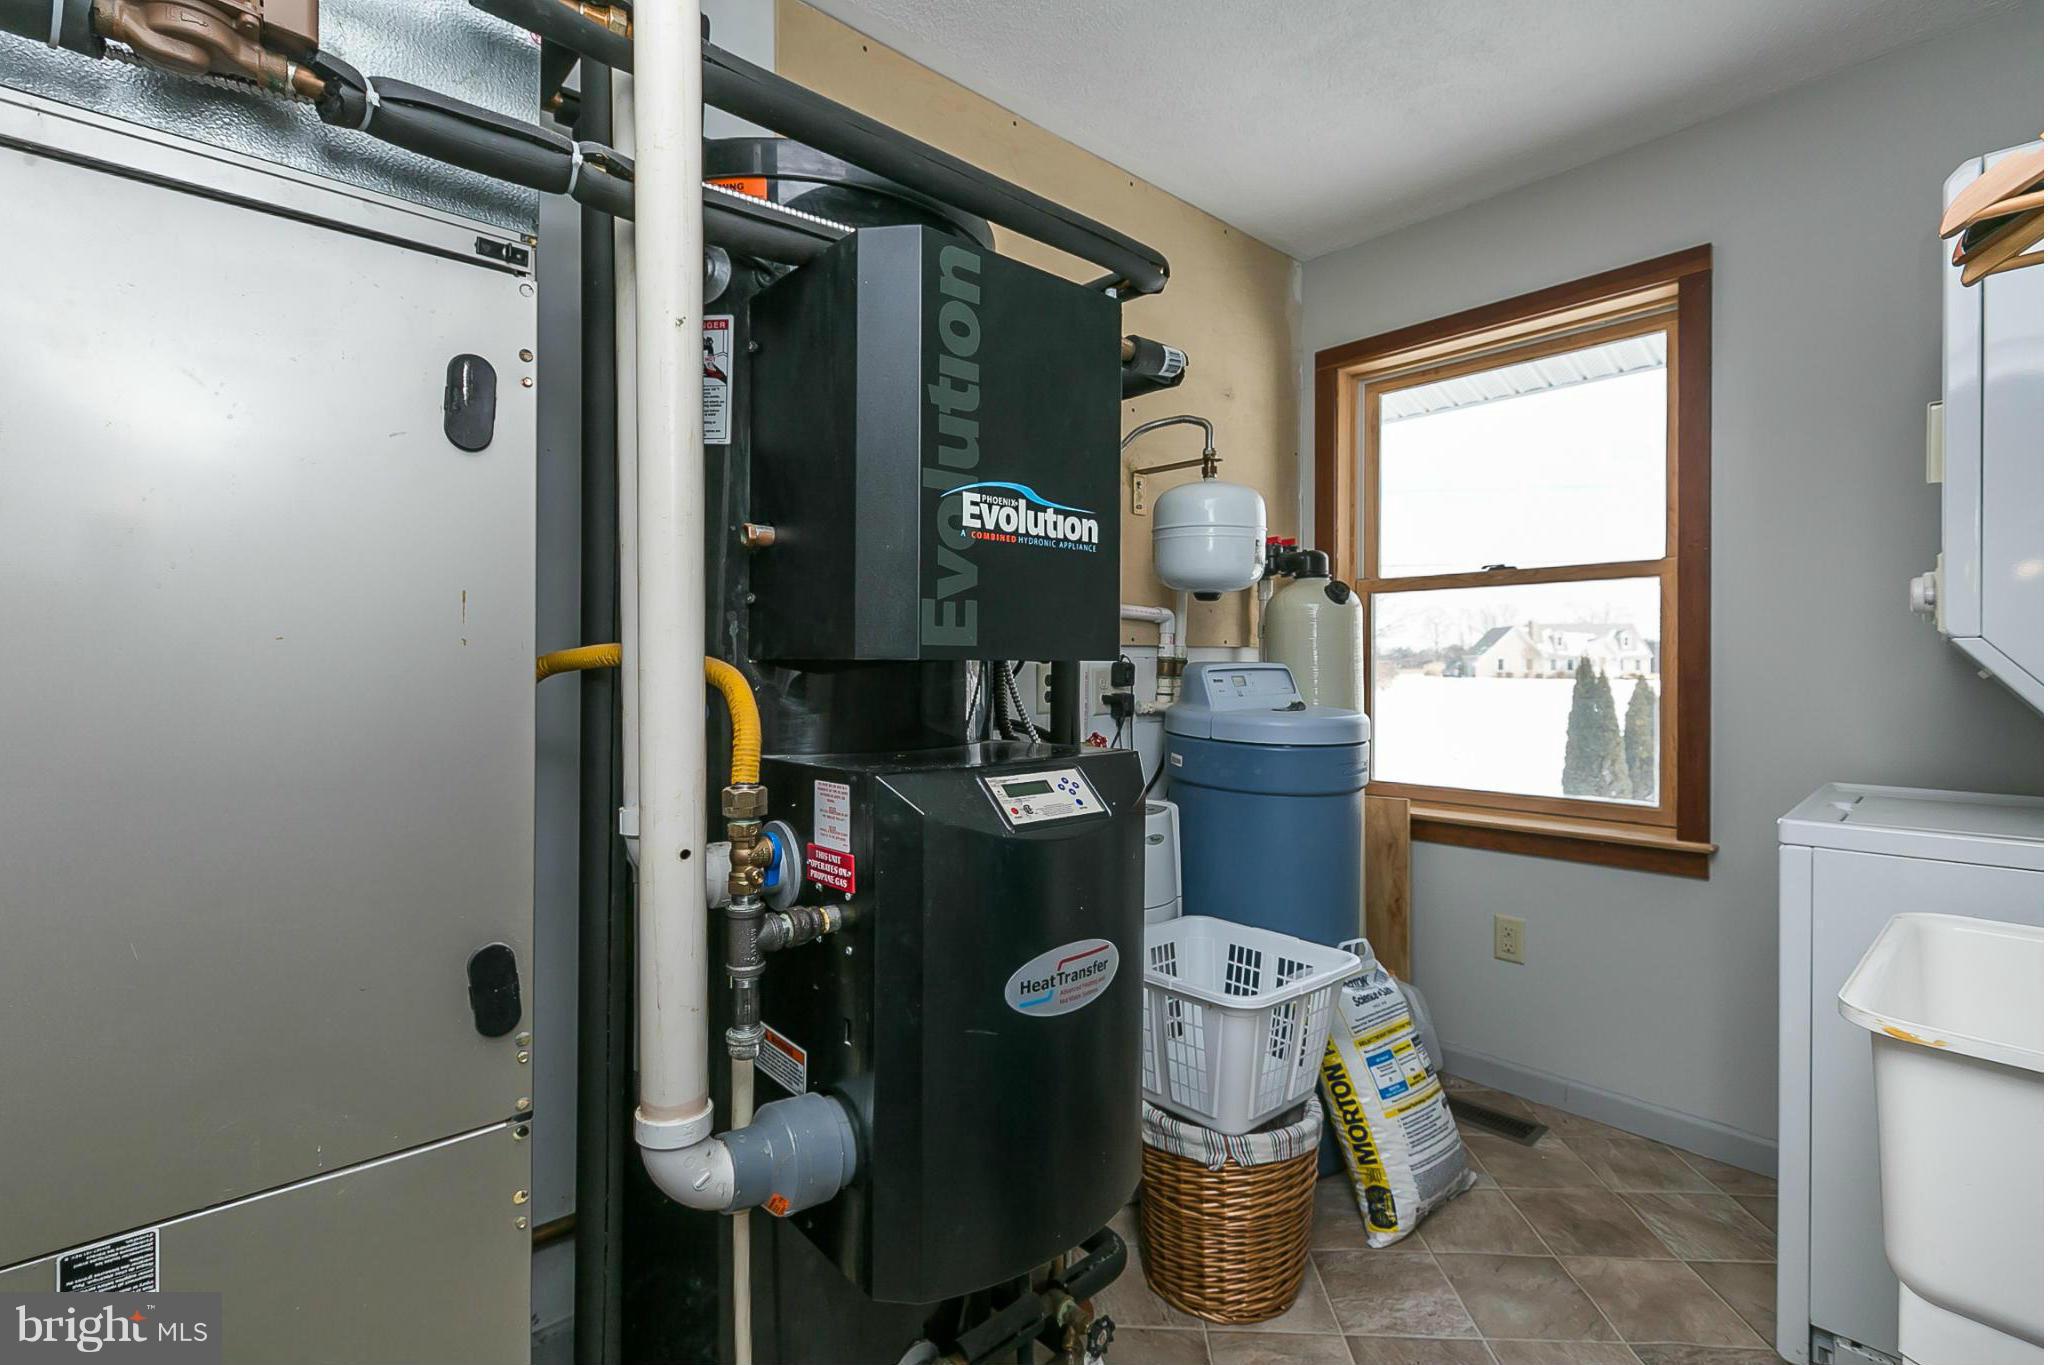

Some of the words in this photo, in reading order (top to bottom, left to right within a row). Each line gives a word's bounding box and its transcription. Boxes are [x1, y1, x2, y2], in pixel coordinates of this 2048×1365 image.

[921, 244, 981, 647] Evolution
[962, 491, 1099, 544] Evolution
[971, 531, 1017, 544] COMBINED
[1018, 536, 1057, 549] HYDRONIC
[1058, 541, 1097, 553] APPLIANCE
[835, 877, 848, 888] GAS
[1324, 1063, 1378, 1166] MORTON
